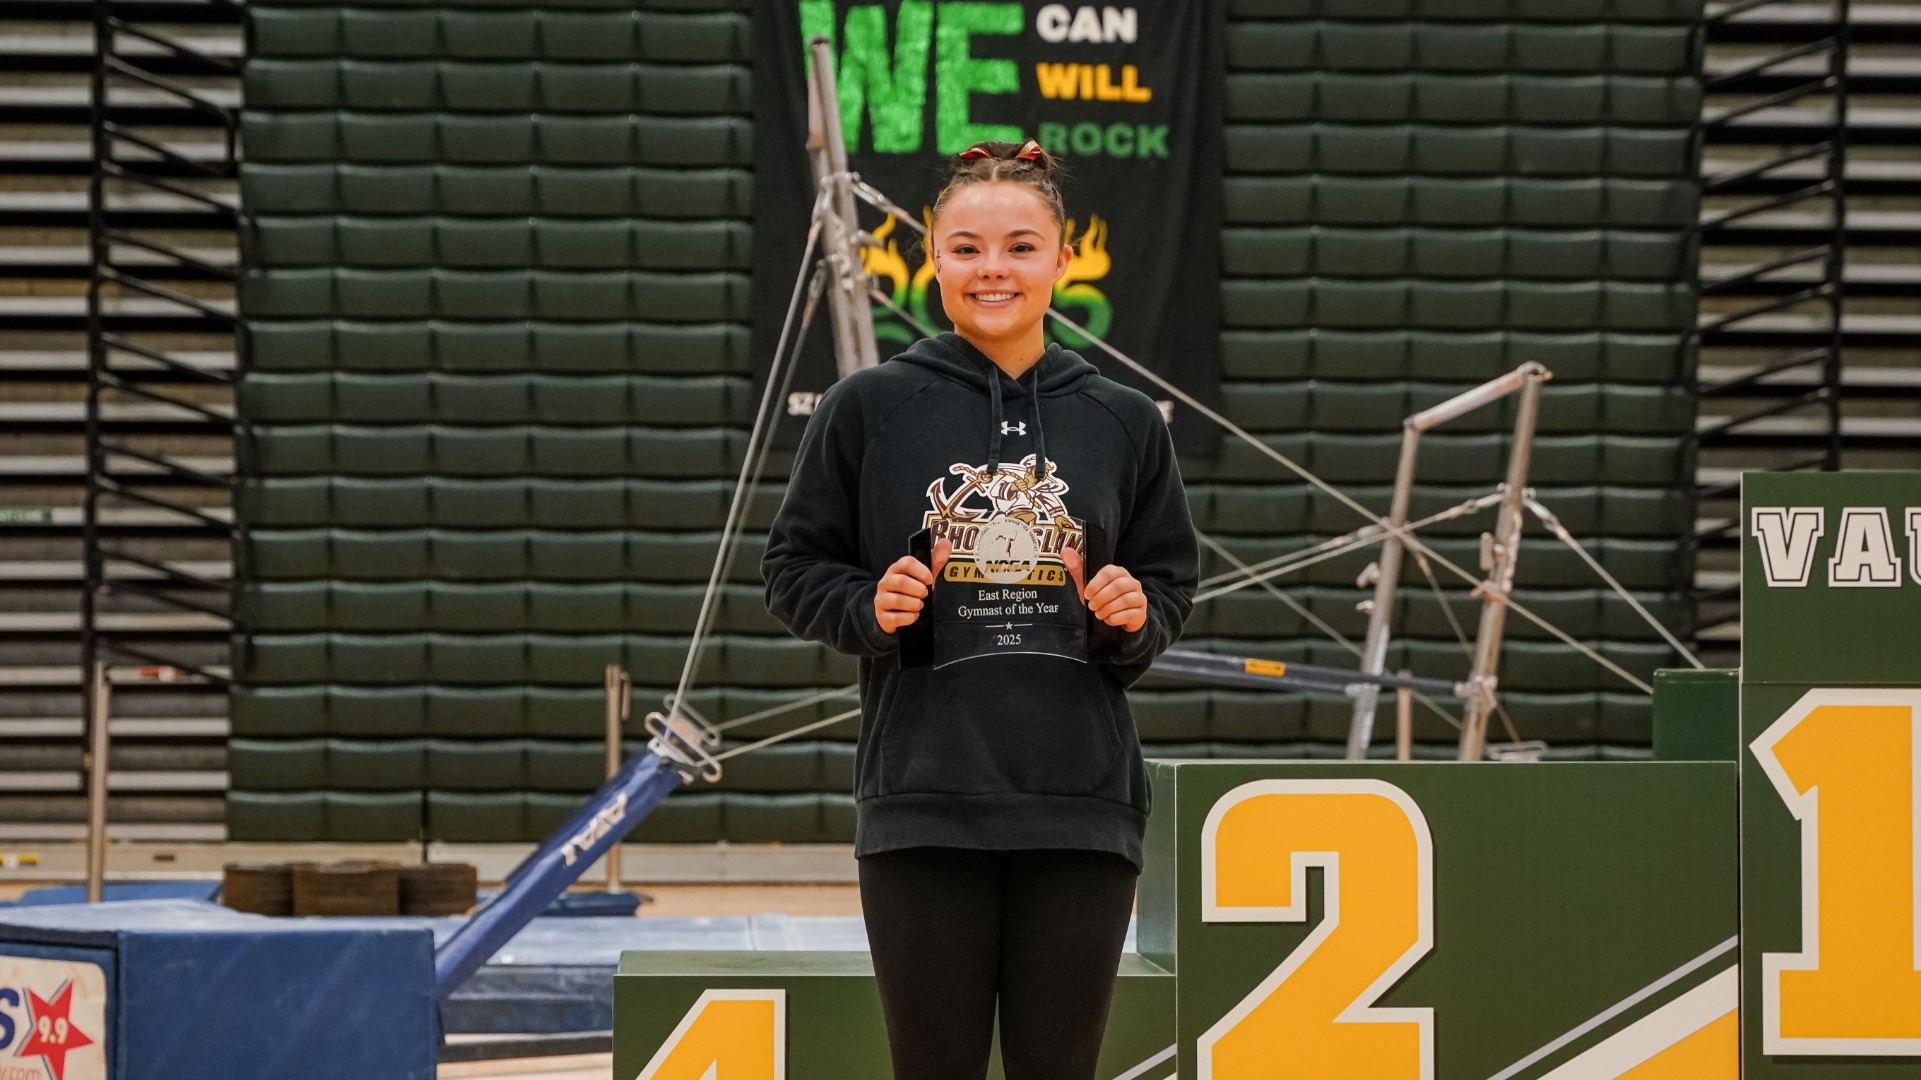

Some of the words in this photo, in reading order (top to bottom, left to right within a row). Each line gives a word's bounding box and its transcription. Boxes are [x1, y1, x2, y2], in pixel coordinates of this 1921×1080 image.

[1036, 4, 1138, 43] CAN
[800, 0, 1024, 156] WE
[1036, 62, 1152, 102] WILL
[1038, 122, 1170, 158] ROCK
[1752, 507, 1921, 587] VA
[957, 605, 1002, 619] Gymnast
[1005, 603, 1017, 615] of
[1018, 603, 1034, 615] the
[1036, 602, 1059, 614] Year
[978, 589, 999, 601] East
[1001, 588, 1038, 602] Region
[997, 634, 1022, 646] 2025
[1749, 688, 1921, 1056] 1
[1197, 778, 1434, 1080] 2
[38, 1015, 69, 1044] 9.9
